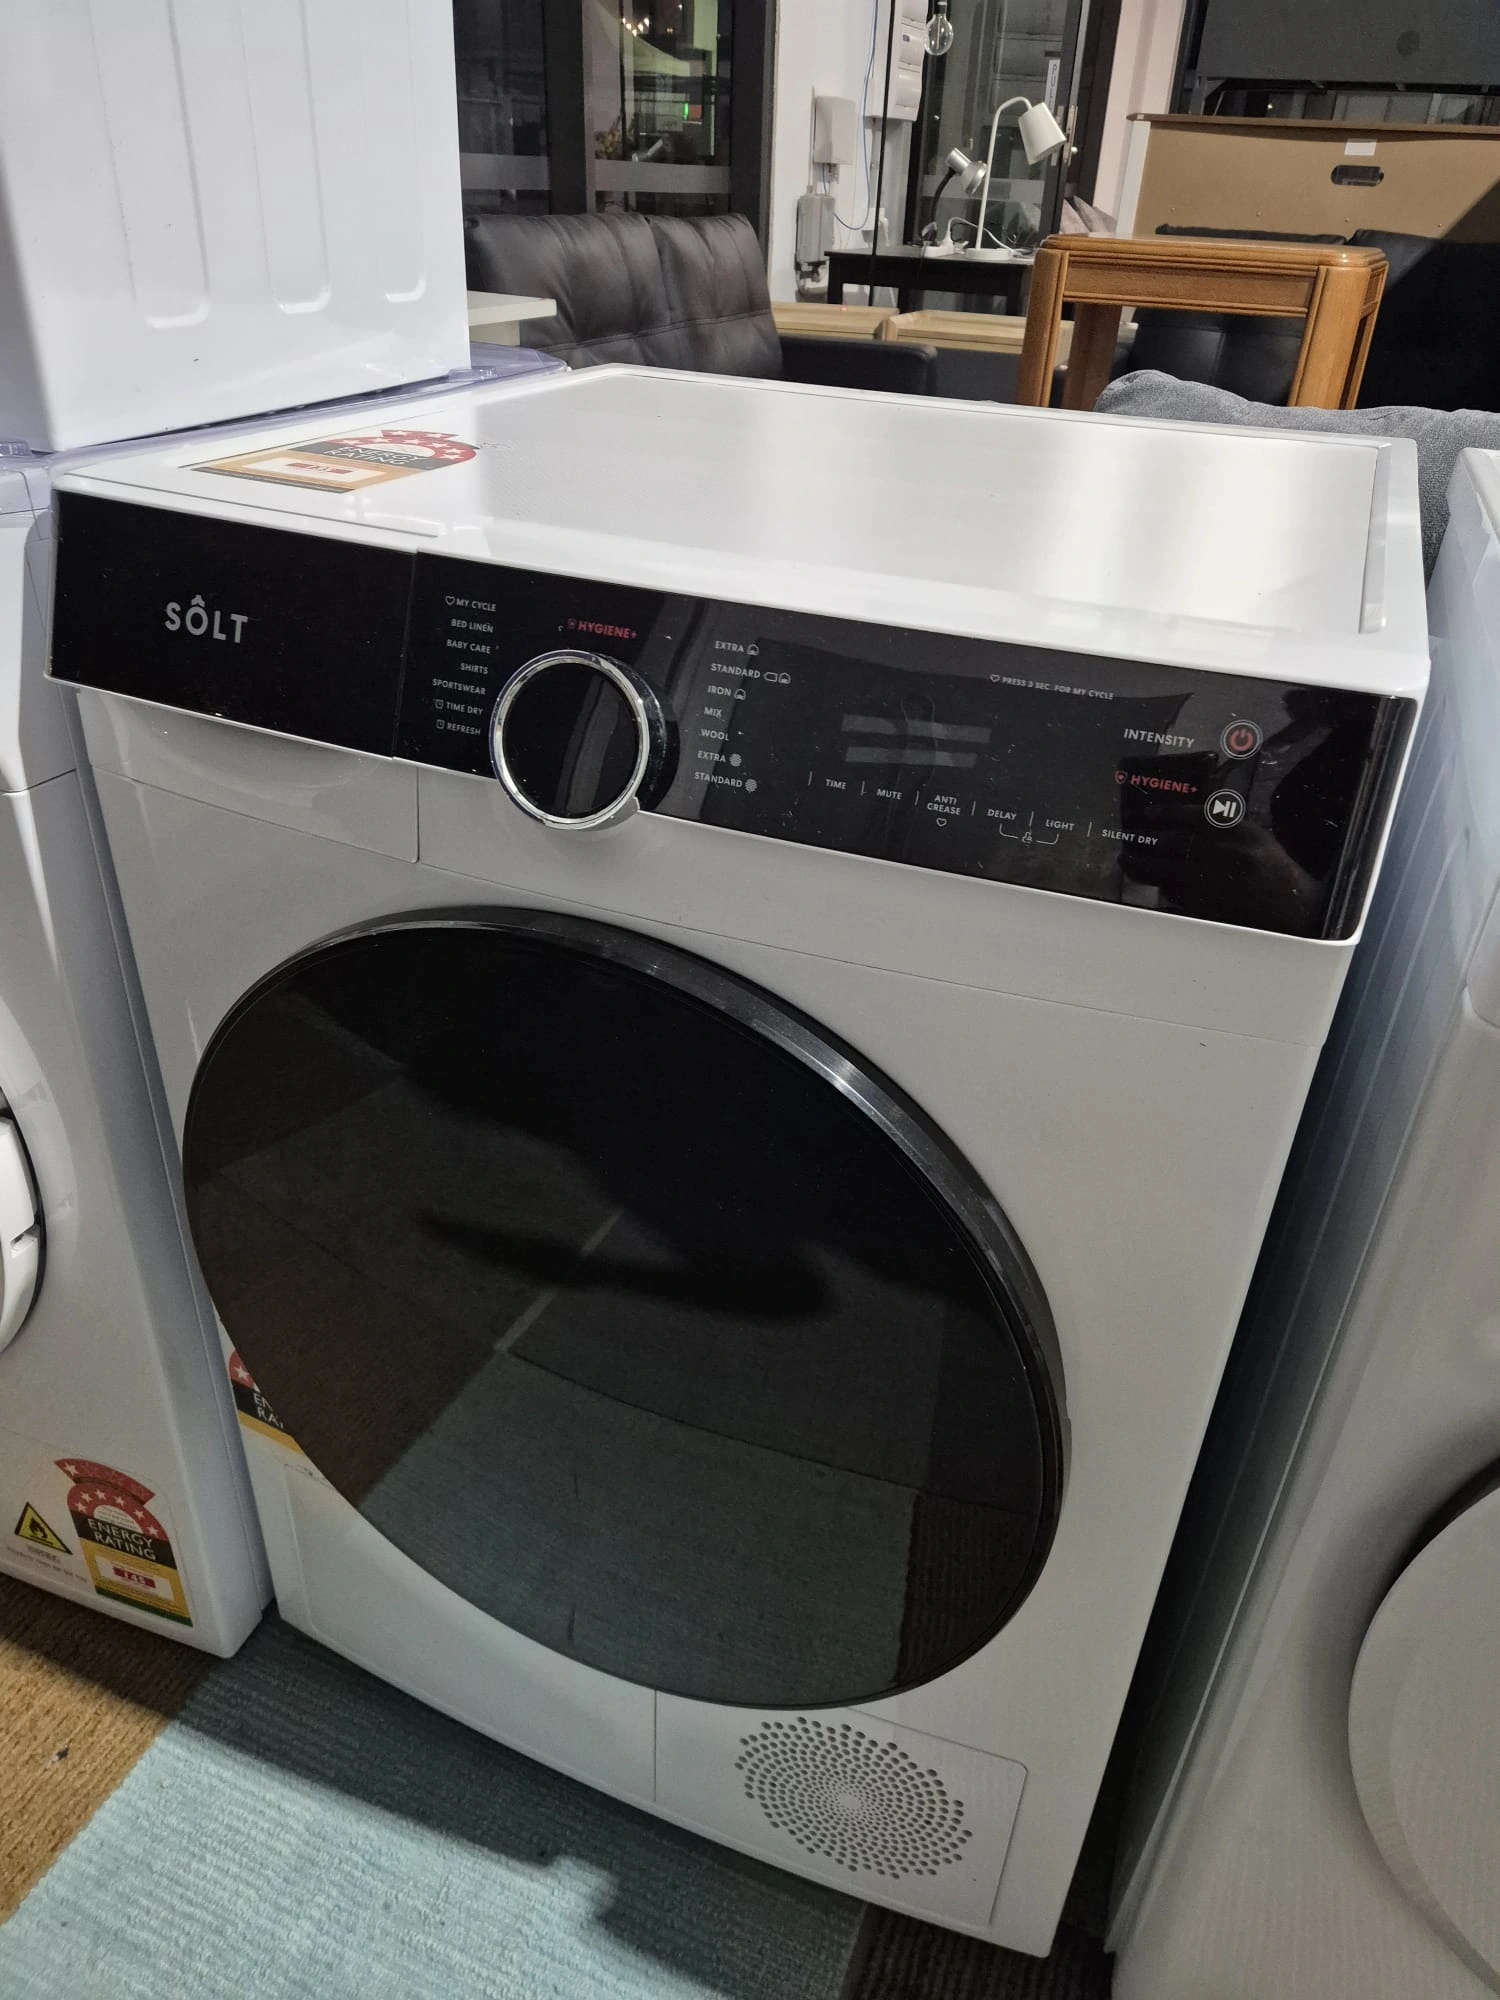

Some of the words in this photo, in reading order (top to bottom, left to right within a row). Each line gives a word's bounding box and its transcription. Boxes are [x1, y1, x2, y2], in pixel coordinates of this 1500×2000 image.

[456, 598, 470, 610] MY
[471, 600, 497, 612] CYCLE
[165, 594, 248, 643] SÔLT
[451, 618, 467, 629] BED
[469, 621, 494, 633] LINEN
[578, 620, 637, 639] HYGIENE+
[446, 639, 469, 651] BABY
[470, 642, 491, 654] CARE
[714, 640, 744, 653] EXTRA
[460, 662, 489, 675] SHIRTS
[710, 662, 761, 679] STANDARD
[432, 678, 486, 696] SPORTSWEAR
[707, 685, 731, 697] IRON
[1002, 676, 1026, 687] PRESS
[1027, 680, 1034, 688] 3
[1054, 685, 1071, 694] FOR
[1072, 688, 1086, 696] MY
[1088, 689, 1114, 700] CYCLE
[446, 701, 465, 713] TIME
[467, 704, 484, 716] DRY
[704, 706, 723, 718] MIX
[447, 722, 481, 736] REFRESH
[701, 728, 729, 741] WOOL
[1124, 728, 1195, 749] INTENSITY
[697, 750, 726, 763] EXTRA
[694, 771, 743, 787] STANDARD
[825, 778, 847, 790] TIME
[1130, 775, 1197, 794] HYGIENE+
[876, 788, 902, 800] MUTE
[934, 795, 957, 805] ANTI
[927, 802, 961, 815] CREASE
[987, 808, 1017, 821] DELAY
[1045, 819, 1075, 832] LIGHT
[1102, 829, 1135, 842] SILENT
[1137, 835, 1159, 847] DRY
[87, 1518, 153, 1549] ENERGY
[94, 1531, 157, 1561] RATING
